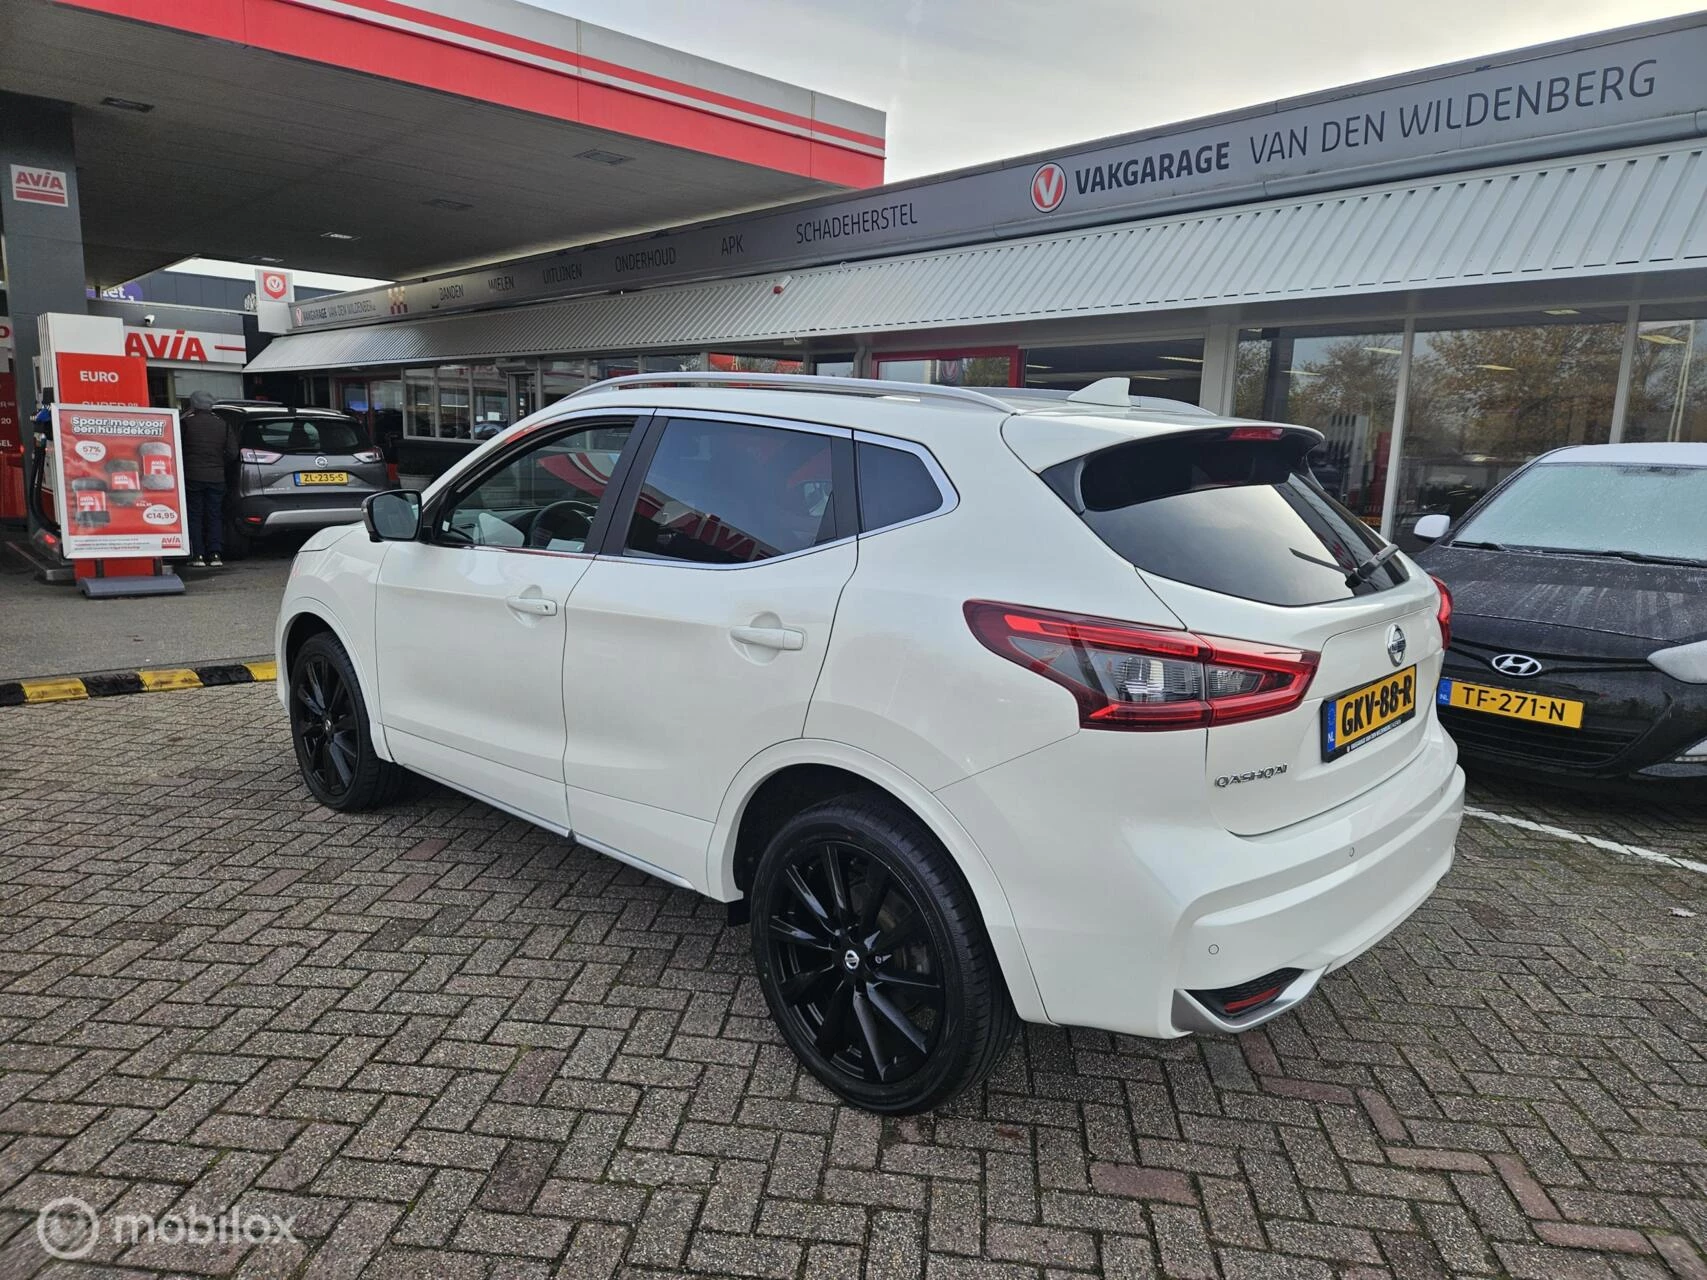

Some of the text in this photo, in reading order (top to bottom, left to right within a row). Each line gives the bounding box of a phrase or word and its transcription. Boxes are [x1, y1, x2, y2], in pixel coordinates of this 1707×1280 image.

[1076, 142, 1230, 194] VAKGARAGE
[1250, 126, 1308, 164] VAN
[1322, 110, 1385, 153] DEN
[1399, 59, 1657, 138] WILDENBERG
[16, 171, 64, 190] AVIA
[439, 284, 465, 301] BANDEN
[488, 275, 515, 293] WIELEN
[614, 246, 677, 273] ONDERHOUD
[721, 234, 744, 257] APK
[796, 202, 918, 244] SCHADEHERSTEL
[125, 329, 208, 362] AVIA
[80, 370, 119, 383] EURO
[72, 416, 165, 428] Spaar mee voor
[73, 426, 97, 434] een
[303, 473, 345, 482] ZL-235-S
[146, 512, 175, 520] €14,95
[162, 536, 181, 544] AVIA
[1341, 674, 1413, 737] GKV-88-R
[1462, 686, 1566, 722] TF-271-N
[1215, 763, 1288, 787] QASHQAI
